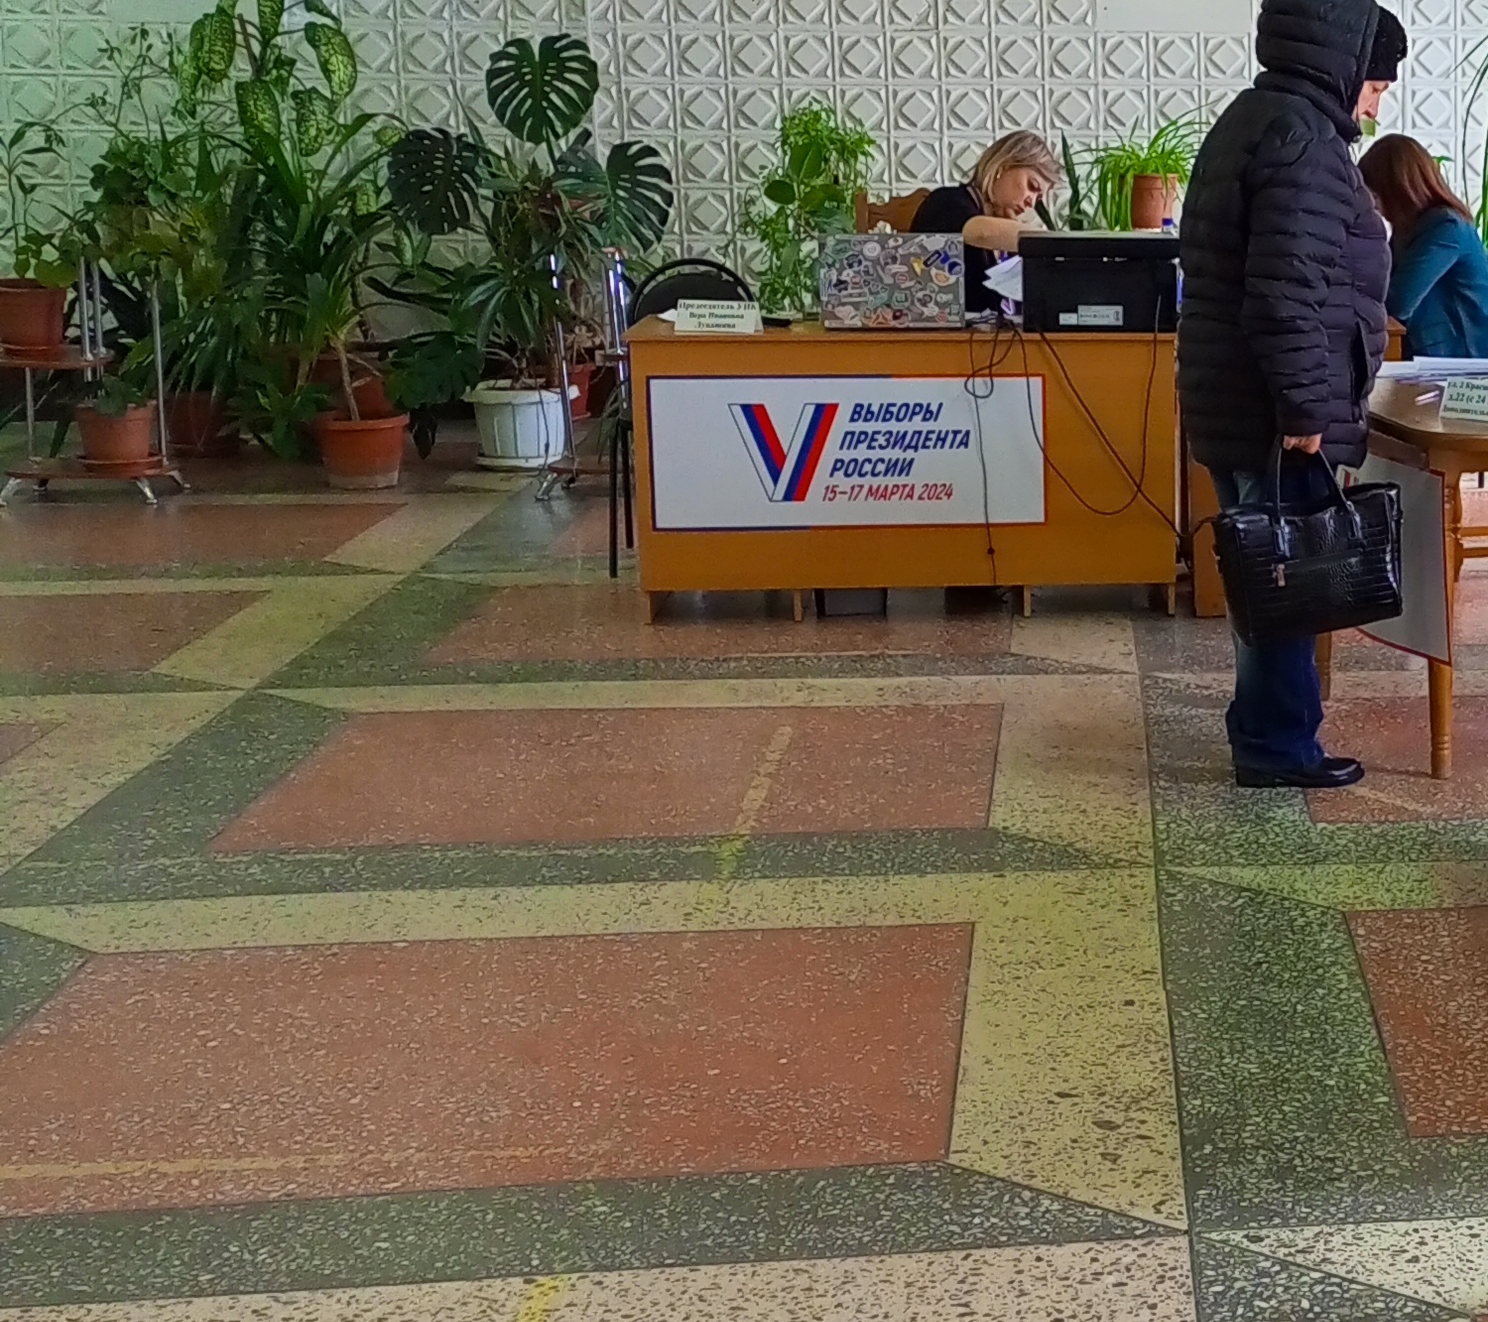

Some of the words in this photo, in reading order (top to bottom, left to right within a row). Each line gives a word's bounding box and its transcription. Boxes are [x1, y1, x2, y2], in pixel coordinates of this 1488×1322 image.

[848, 402, 943, 423] ВЫБОРЫ
[838, 429, 971, 453] ПРЕЗИДЕНТА
[829, 457, 915, 478] РОССИИ
[864, 483, 916, 502] МАРТА
[917, 482, 954, 501] 2024
